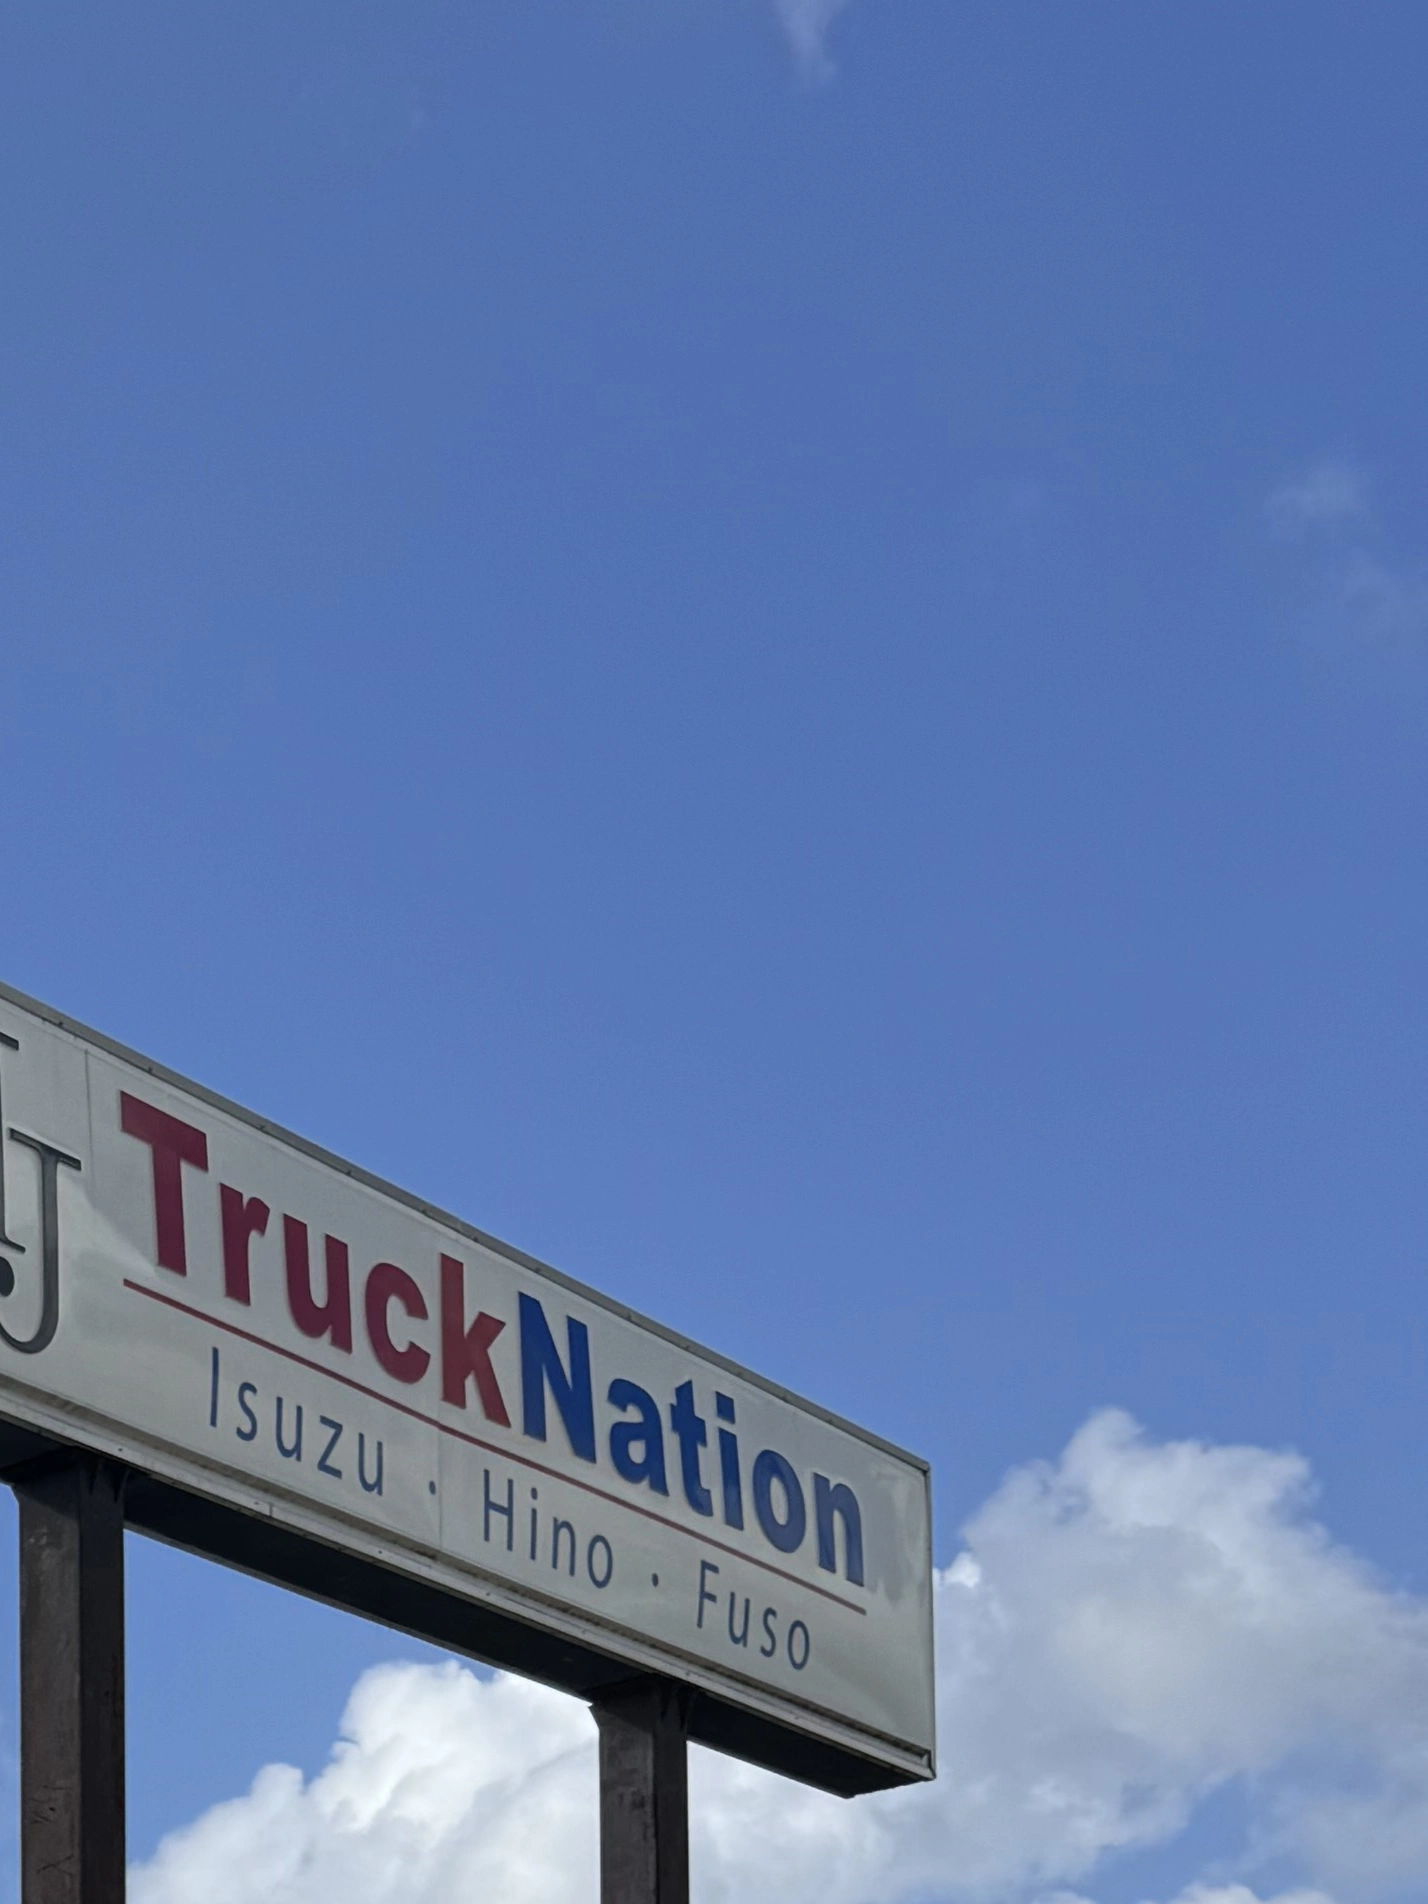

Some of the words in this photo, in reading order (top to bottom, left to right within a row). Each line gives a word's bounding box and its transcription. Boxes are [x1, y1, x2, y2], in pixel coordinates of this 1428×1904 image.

[120, 1091, 864, 1587] TruckNation
[210, 1347, 384, 1496] Isuzu
[484, 1468, 613, 1588] Hino
[697, 1560, 810, 1671] Fuso
